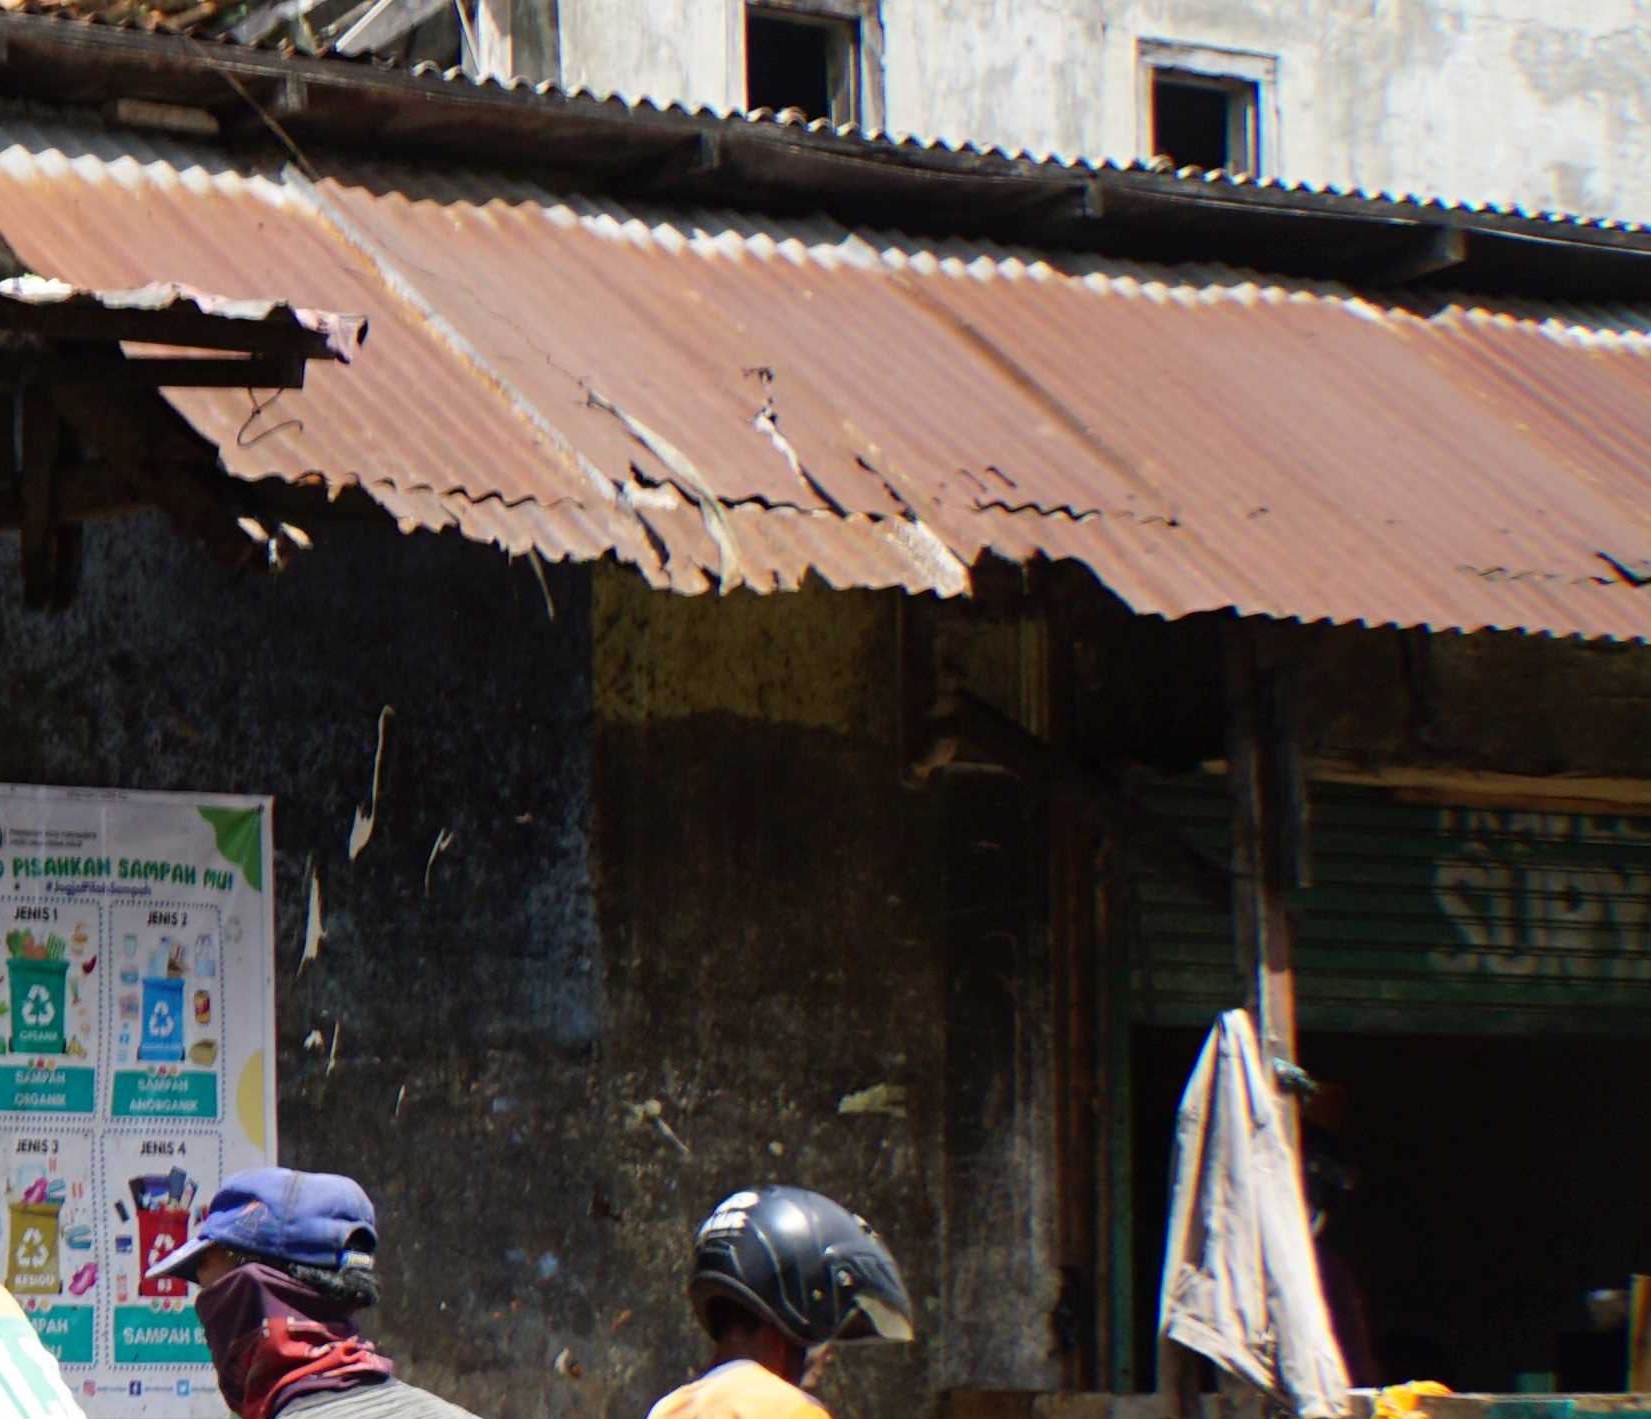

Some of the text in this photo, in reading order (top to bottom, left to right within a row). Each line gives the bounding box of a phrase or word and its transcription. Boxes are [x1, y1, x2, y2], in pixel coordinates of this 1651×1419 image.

[117, 857, 196, 886] SAMPAH
[14, 906, 50, 922] JENIS
[147, 911, 178, 926] JENIS
[16, 1138, 60, 1154] JENIS 3
[140, 1141, 187, 1156] JENIS 4
[123, 1327, 190, 1345] SAMPAH
